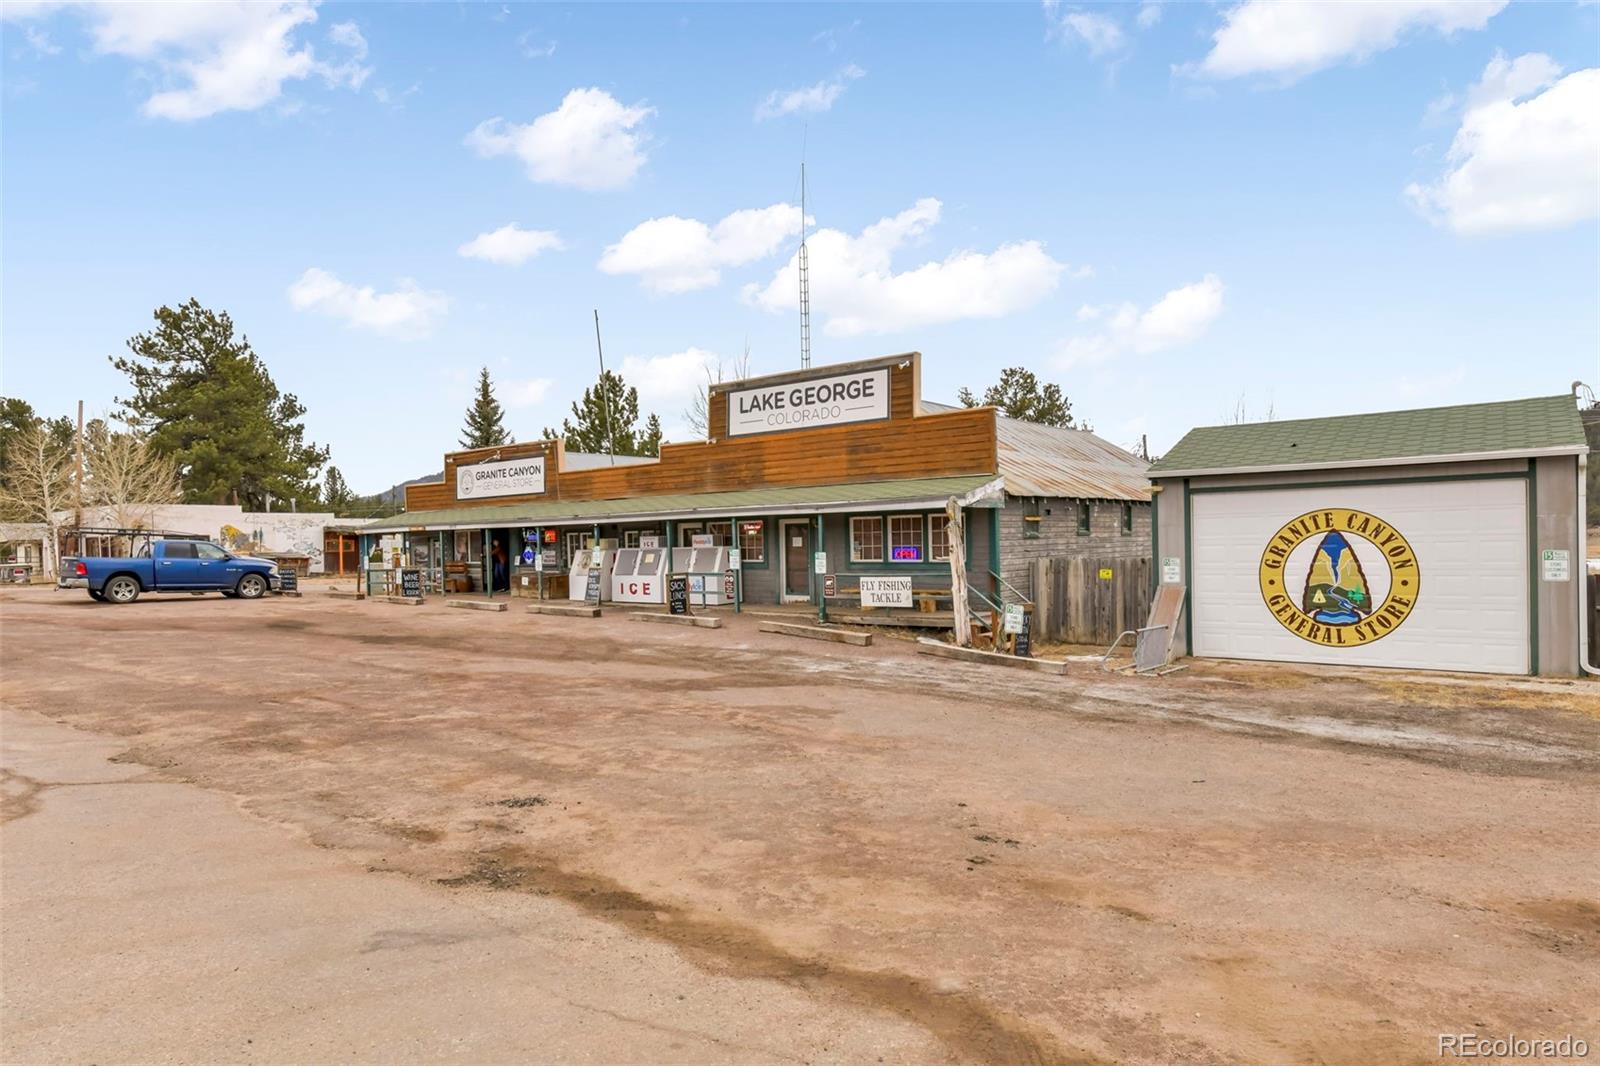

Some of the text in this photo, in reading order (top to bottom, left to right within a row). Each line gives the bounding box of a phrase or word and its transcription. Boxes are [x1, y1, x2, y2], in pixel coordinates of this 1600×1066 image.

[739, 378, 875, 414] LAKE GEORGE
[767, 405, 841, 426] COLORADO
[475, 464, 541, 481] GRANITE CANYON
[483, 477, 534, 490] GENERAL STORE
[1264, 512, 1414, 570] GRANITE CANYON
[895, 550, 916, 559] OPEN
[402, 573, 420, 581] WINE
[404, 581, 420, 589] BEER
[620, 582, 651, 595] ICE
[670, 580, 686, 592] SACK
[861, 580, 912, 592] FLY FISHING
[670, 591, 687, 601] LUNC
[870, 592, 902, 604] TACKLE
[1268, 594, 1411, 644] GENERAL STORE
